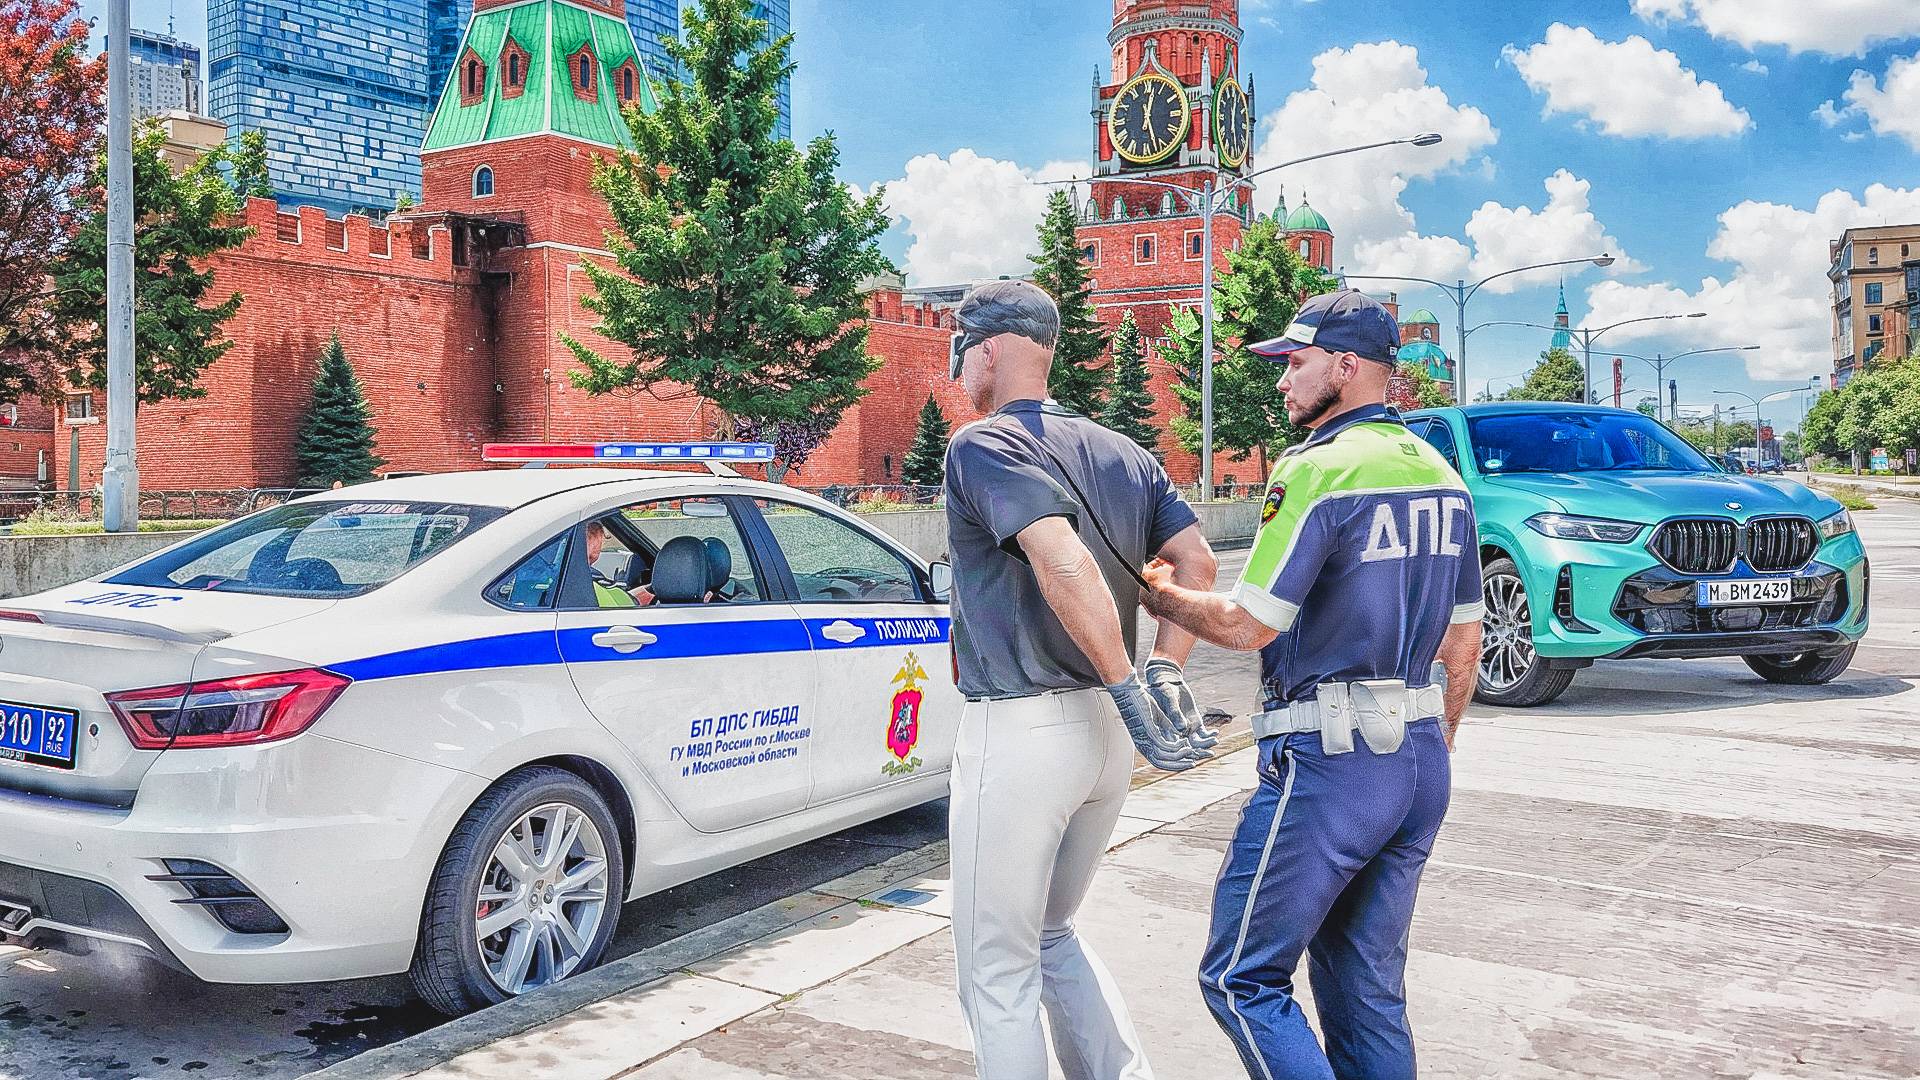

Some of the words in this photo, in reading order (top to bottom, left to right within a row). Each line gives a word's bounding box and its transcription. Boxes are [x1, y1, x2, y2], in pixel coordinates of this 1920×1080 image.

[1360, 496, 1466, 563] ДПС
[65, 592, 183, 608] ДПС
[1709, 584, 1720, 600] M
[1730, 583, 1750, 600] BM
[1753, 582, 1789, 600] 2439
[874, 619, 941, 642] ПОЛИЦИЯ
[48, 716, 65, 742] 92
[690, 718, 714, 738] БП
[715, 712, 749, 738] ДПС
[752, 704, 800, 729] ГИБДД
[46, 741, 62, 753] RUS
[669, 745, 685, 761] ГУ
[686, 742, 713, 759] МВД
[714, 739, 753, 754] России
[754, 735, 768, 747] по
[682, 764, 690, 777] и
[691, 751, 756, 775] Московской
[757, 746, 799, 763] области
